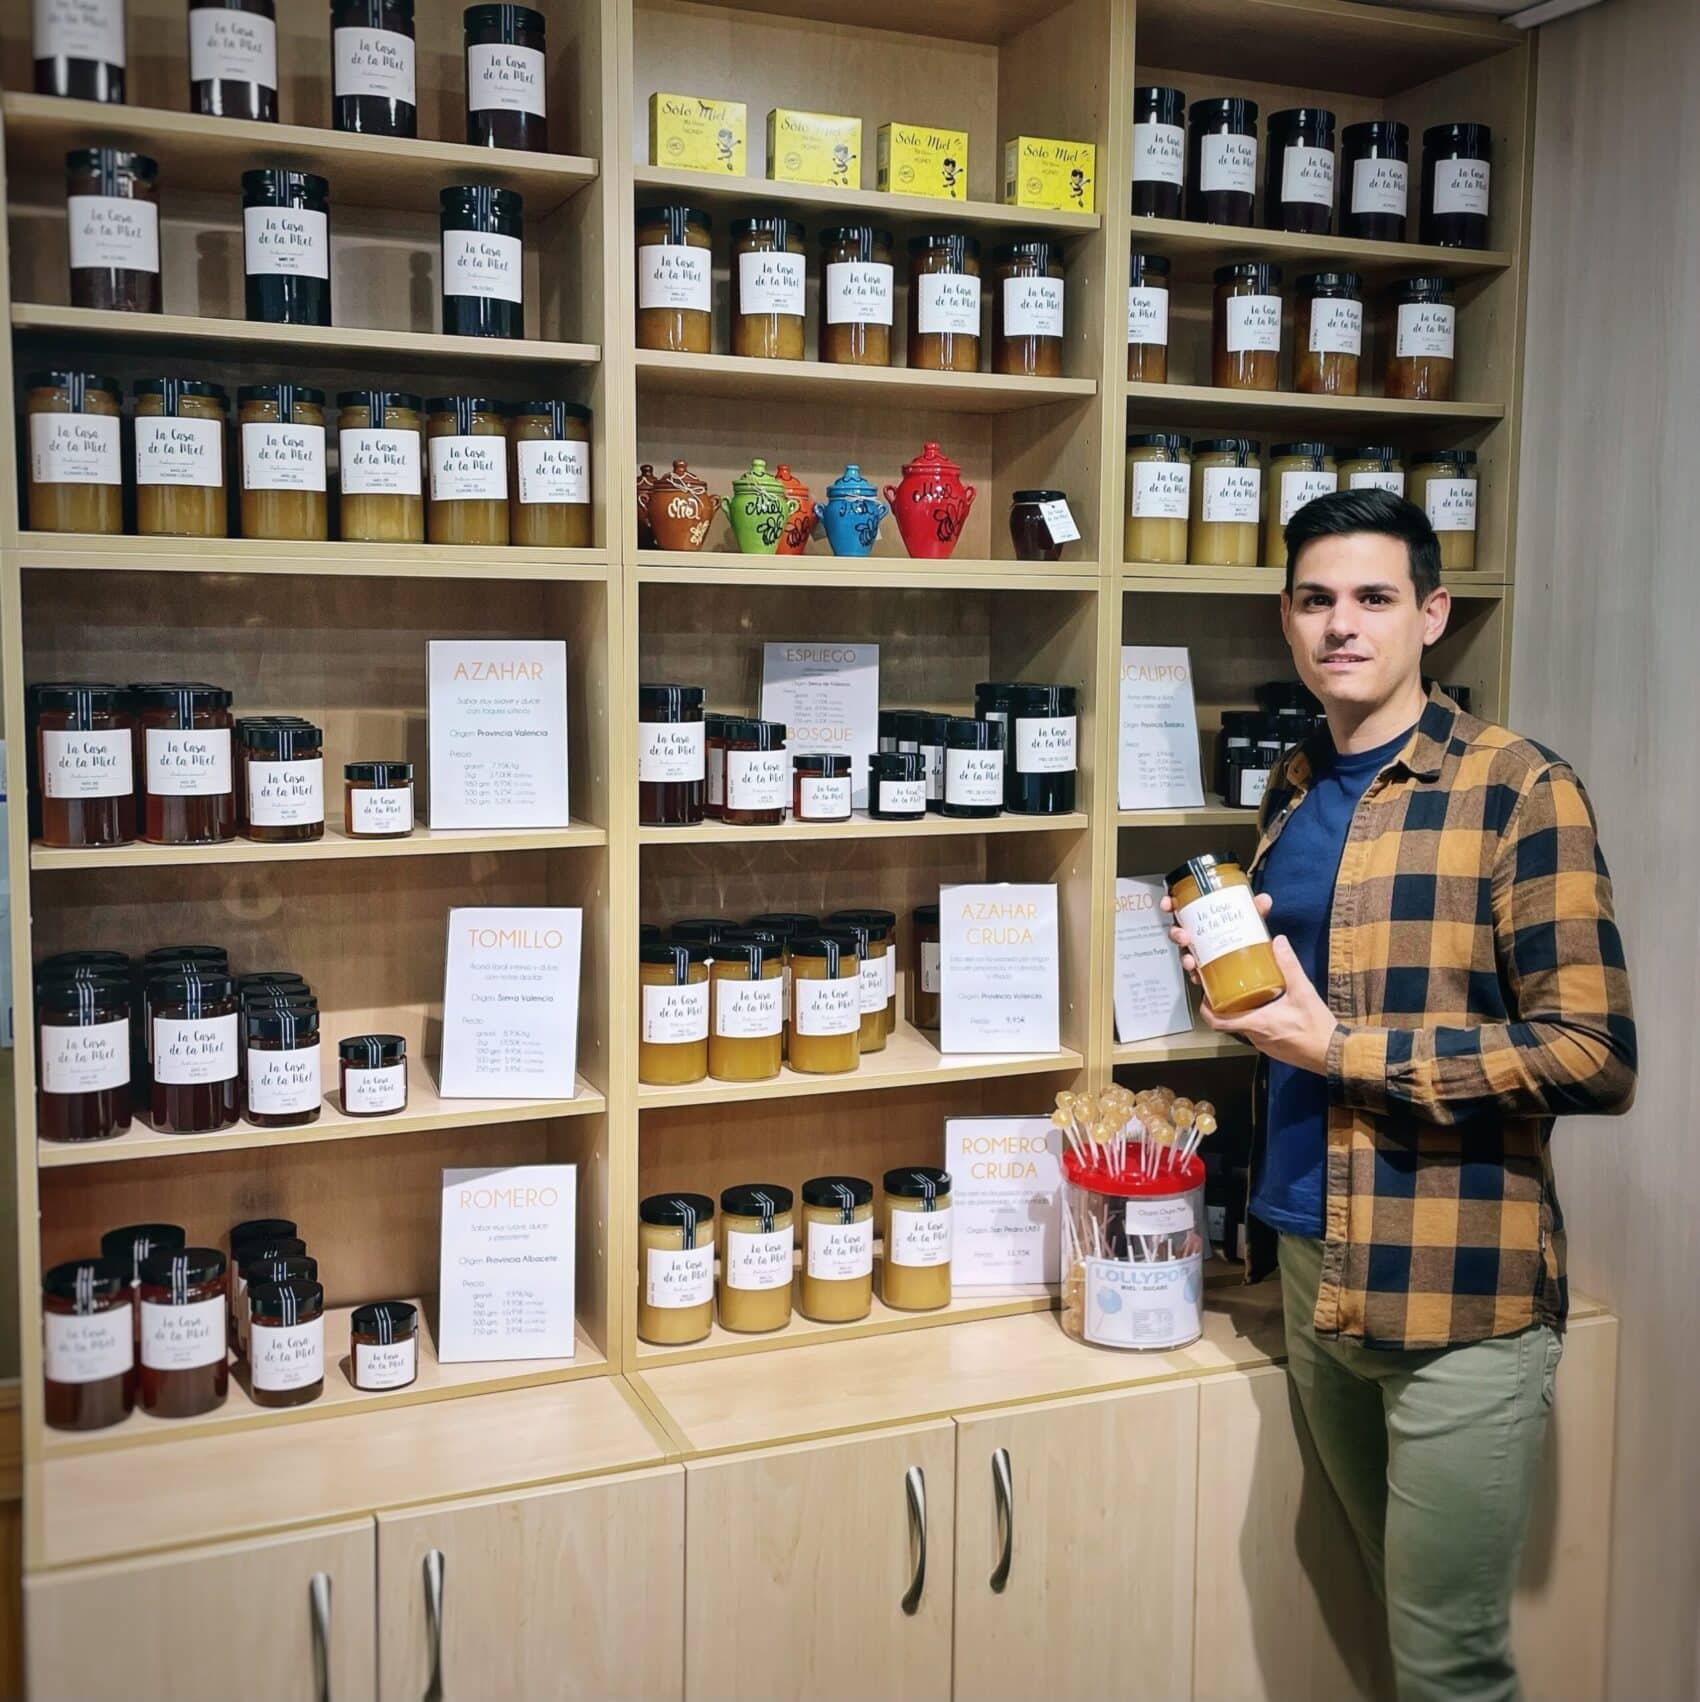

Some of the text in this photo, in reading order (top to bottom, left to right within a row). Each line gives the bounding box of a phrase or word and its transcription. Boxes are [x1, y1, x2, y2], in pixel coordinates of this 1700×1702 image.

[506, 56, 527, 69] Casa
[483, 68, 493, 80] de
[513, 71, 534, 84] Miel
[927, 134, 951, 151] Miel
[1055, 148, 1079, 161] Miel
[281, 219, 303, 232] Casa
[258, 232, 268, 244] de
[290, 234, 312, 247] Miel
[481, 244, 501, 257] Casa
[457, 256, 466, 267] de
[487, 258, 508, 271] Miel
[676, 257, 695, 268] Casa
[777, 263, 793, 274] Casa
[653, 268, 663, 280] de
[683, 270, 701, 281] Miel
[755, 275, 764, 287] de
[783, 276, 800, 288] Miel
[171, 429, 194, 441] Casa
[282, 435, 304, 448] Casa
[148, 442, 159, 453] de
[180, 443, 203, 455] Miel
[376, 440, 397, 452] Casa
[258, 449, 269, 459] de
[290, 450, 312, 461] Miel
[353, 454, 363, 464] de
[384, 455, 405, 465] Miel
[786, 648, 857, 664] ESPLIEGO
[454, 661, 544, 680] AZAHAR
[477, 728, 513, 737] Provincia
[514, 728, 548, 737] Valencia
[787, 727, 853, 742] BOSQUE
[83, 743, 107, 754] Casa
[183, 741, 207, 752] Casa
[58, 756, 69, 767] de
[92, 755, 116, 766] Miel
[160, 754, 170, 766] de
[191, 754, 215, 765] Miel
[283, 773, 305, 783] Casa
[261, 786, 271, 796] de
[292, 784, 312, 795] Miel
[961, 903, 1037, 920] AZAHAR
[468, 929, 563, 949] TOMILLO
[966, 928, 1033, 945] CRUDA
[521, 993, 554, 1002] Valencia
[194, 1031, 216, 1042] Casa
[169, 1044, 180, 1056] de
[202, 1042, 224, 1054] Miel
[285, 1062, 305, 1071] Casa
[261, 1075, 271, 1085] de
[293, 1072, 312, 1084] Miel
[961, 1136, 1047, 1155] ROMERO
[971, 1162, 1038, 1180] CRUDA
[460, 1187, 558, 1209] ROMERO
[486, 1255, 521, 1264] Provincia
[522, 1254, 557, 1263] Albacete
[1095, 1265, 1190, 1284] LOLLYPOP
